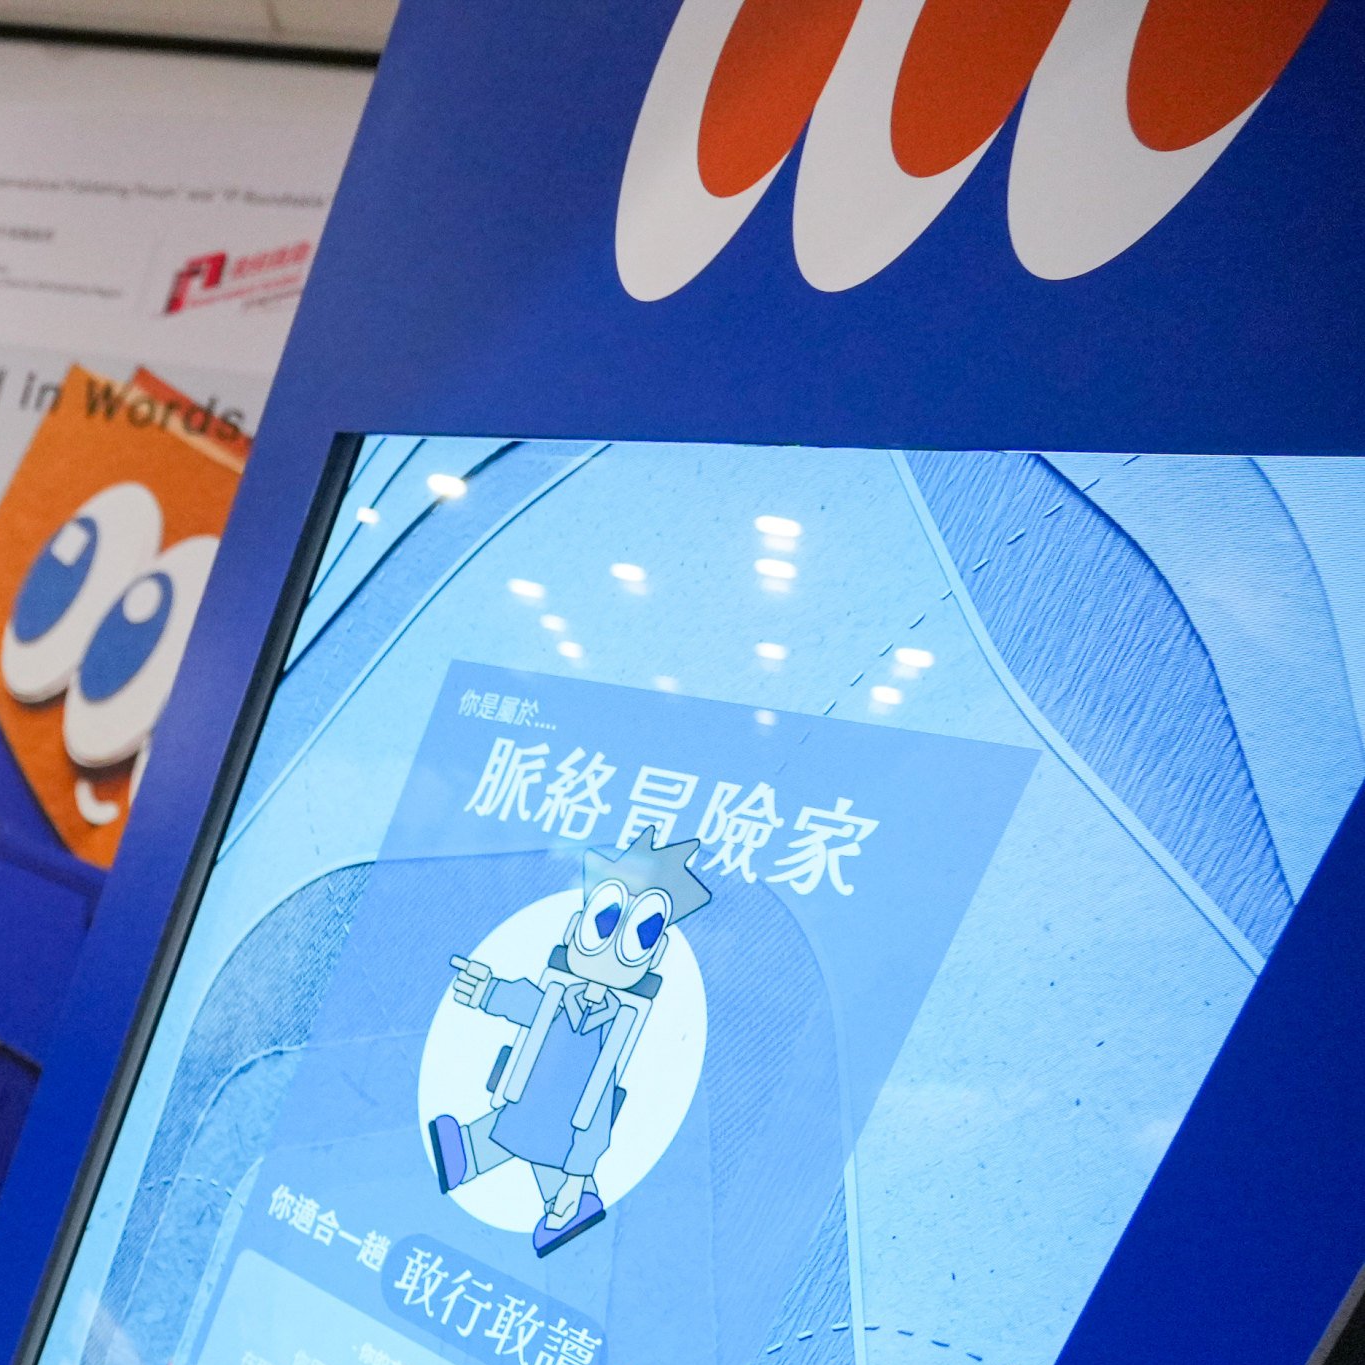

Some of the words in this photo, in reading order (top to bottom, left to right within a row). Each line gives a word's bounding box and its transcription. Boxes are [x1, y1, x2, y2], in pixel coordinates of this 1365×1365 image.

[20, 373, 63, 413] in
[83, 378, 247, 446] Words
[463, 737, 879, 896] 脈絡冒險家
[267, 1183, 391, 1273] 你適合一趟
